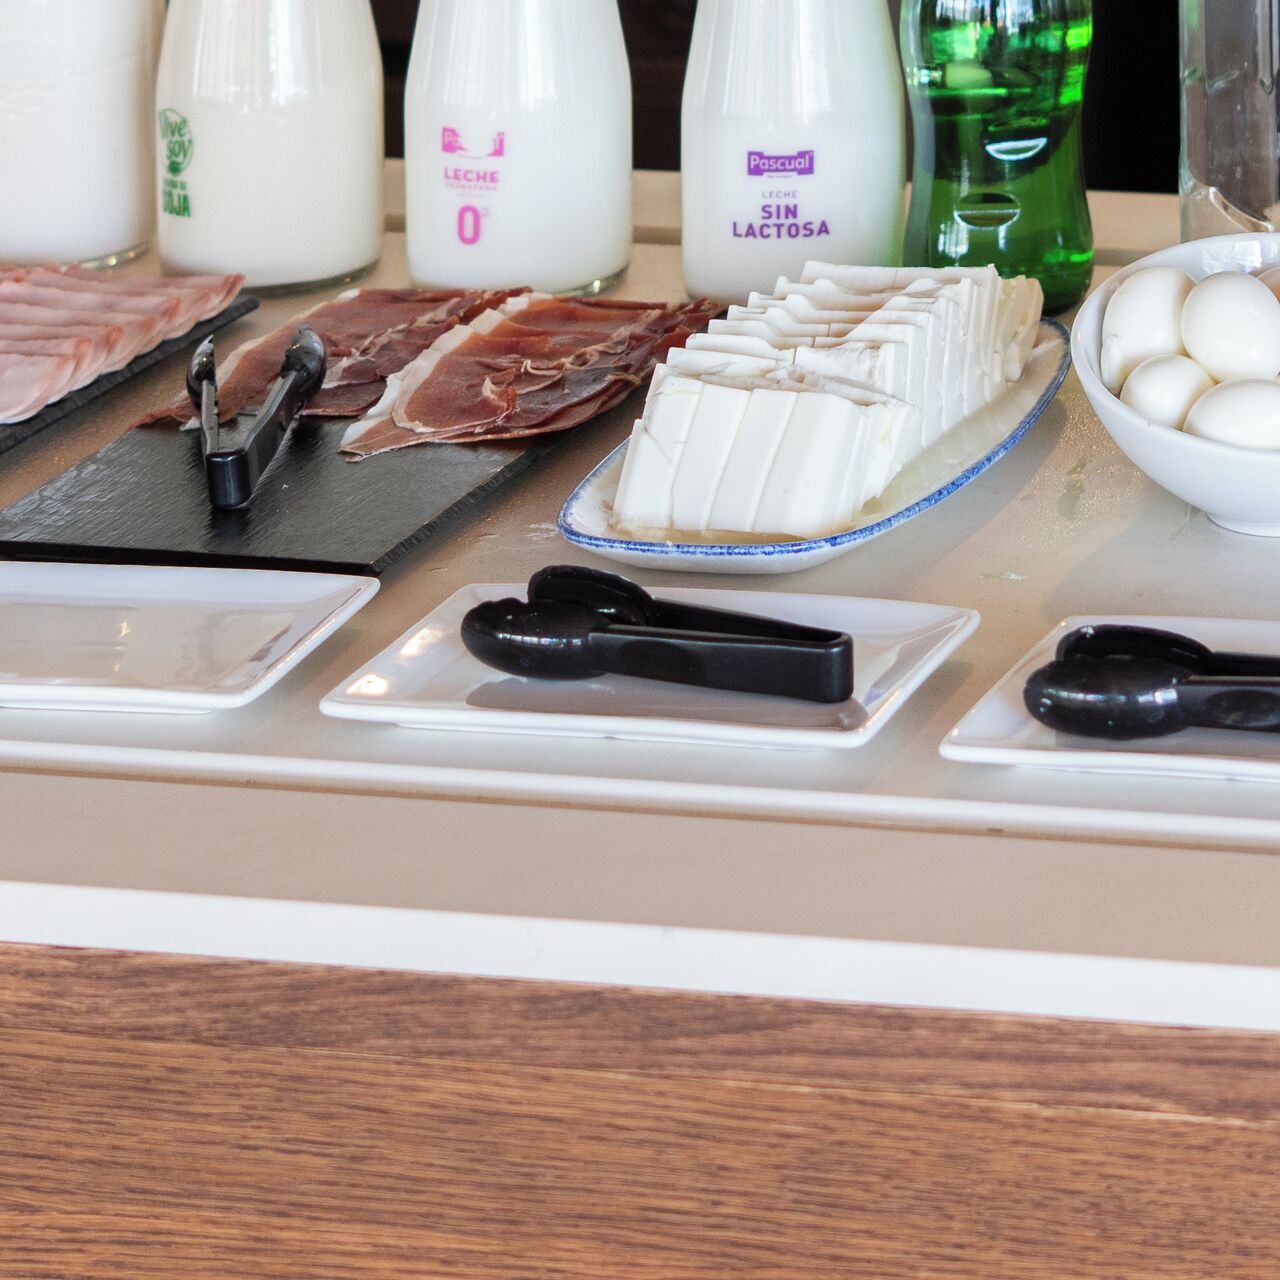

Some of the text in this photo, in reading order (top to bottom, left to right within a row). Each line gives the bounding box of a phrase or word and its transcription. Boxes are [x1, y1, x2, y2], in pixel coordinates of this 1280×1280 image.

[750, 154, 810, 170] Pascual
[444, 168, 499, 183] LECHE
[762, 190, 798, 199] LECHE
[761, 204, 798, 220] SIN
[732, 220, 830, 239] LACTOSA
